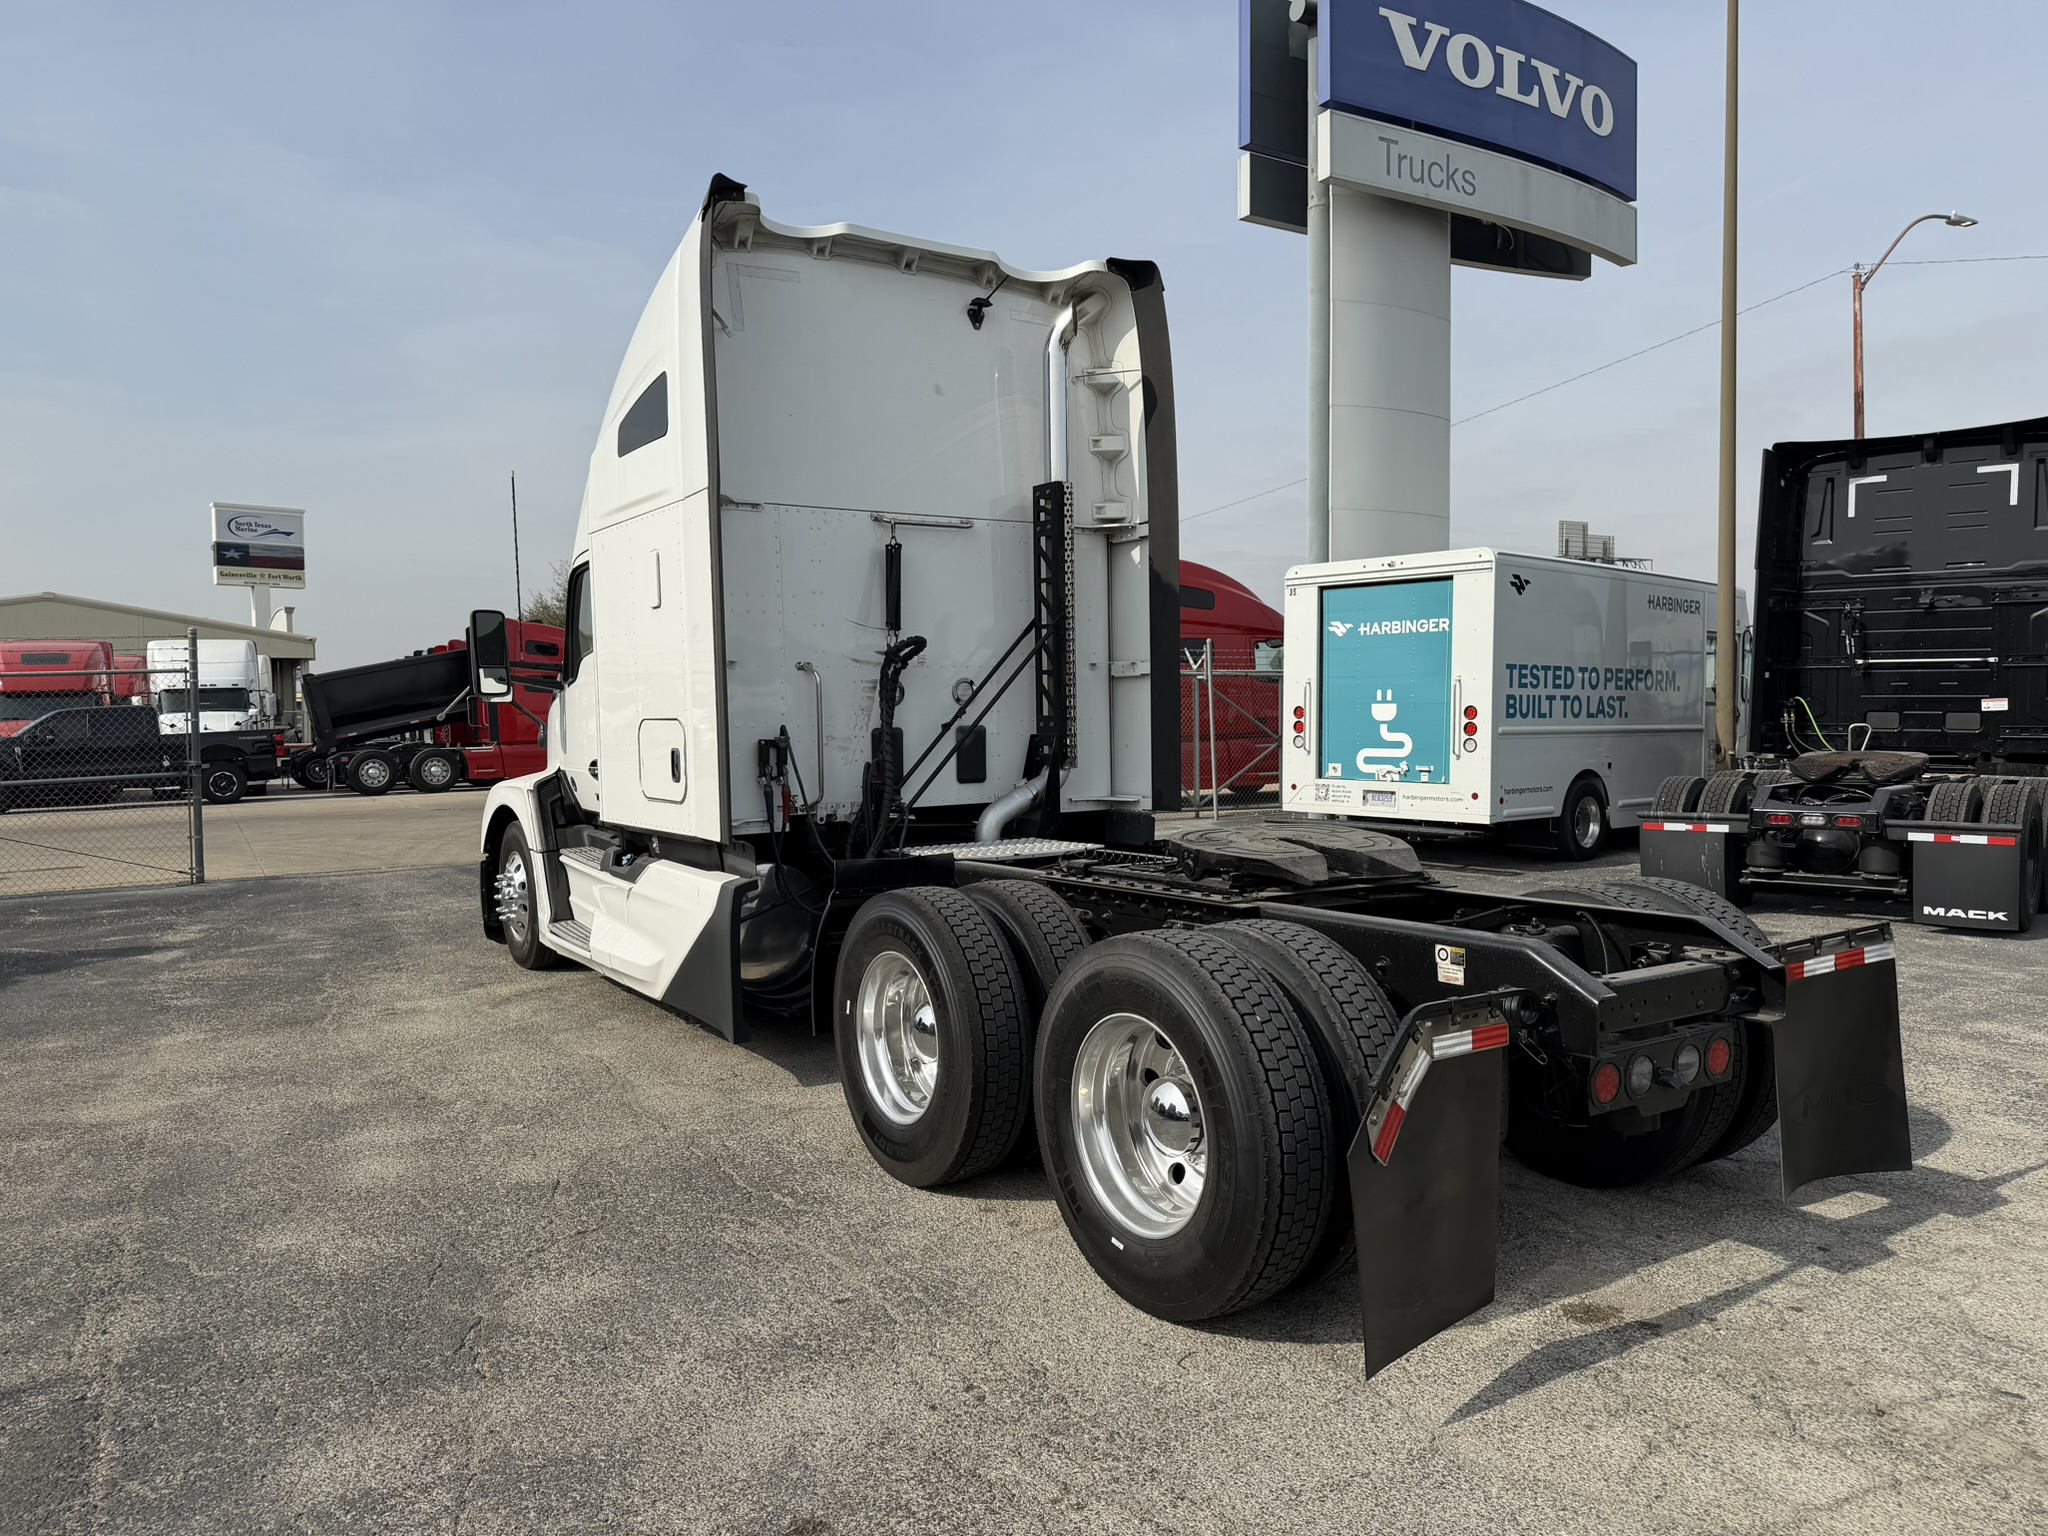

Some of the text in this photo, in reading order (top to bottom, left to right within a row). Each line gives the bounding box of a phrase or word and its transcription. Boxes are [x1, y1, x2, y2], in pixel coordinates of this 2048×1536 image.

[1378, 6, 1614, 137] VOLVO
[1377, 135, 1477, 197] Trucks
[234, 520, 253, 528] North
[220, 570, 257, 579] Gainesville
[1646, 592, 1701, 615] HARBINGER
[1358, 617, 1450, 636] HARBINGER
[1505, 662, 1681, 693] TESTED TO PERFORM.
[1505, 694, 1629, 720] BUILT TO LAST.
[1402, 794, 1464, 803] harbingermotors.com
[1504, 786, 1553, 795] harbingermotors.com
[1922, 905, 2009, 922] MACK
